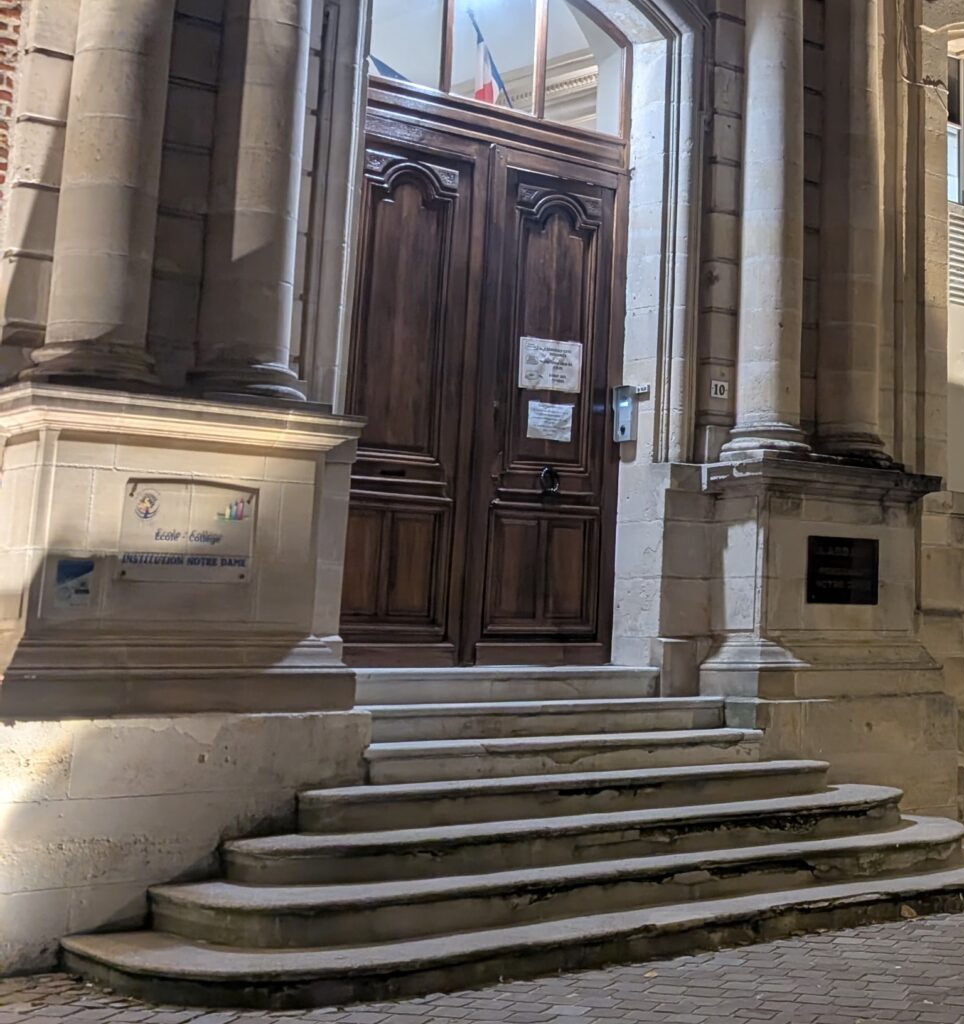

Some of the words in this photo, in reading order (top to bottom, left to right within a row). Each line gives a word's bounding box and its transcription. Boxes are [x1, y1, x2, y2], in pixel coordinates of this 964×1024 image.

[714, 383, 725, 396] 10
[121, 554, 184, 565] INSTITUTION
[187, 557, 218, 566] NOTRE
[220, 558, 246, 567] DAME
